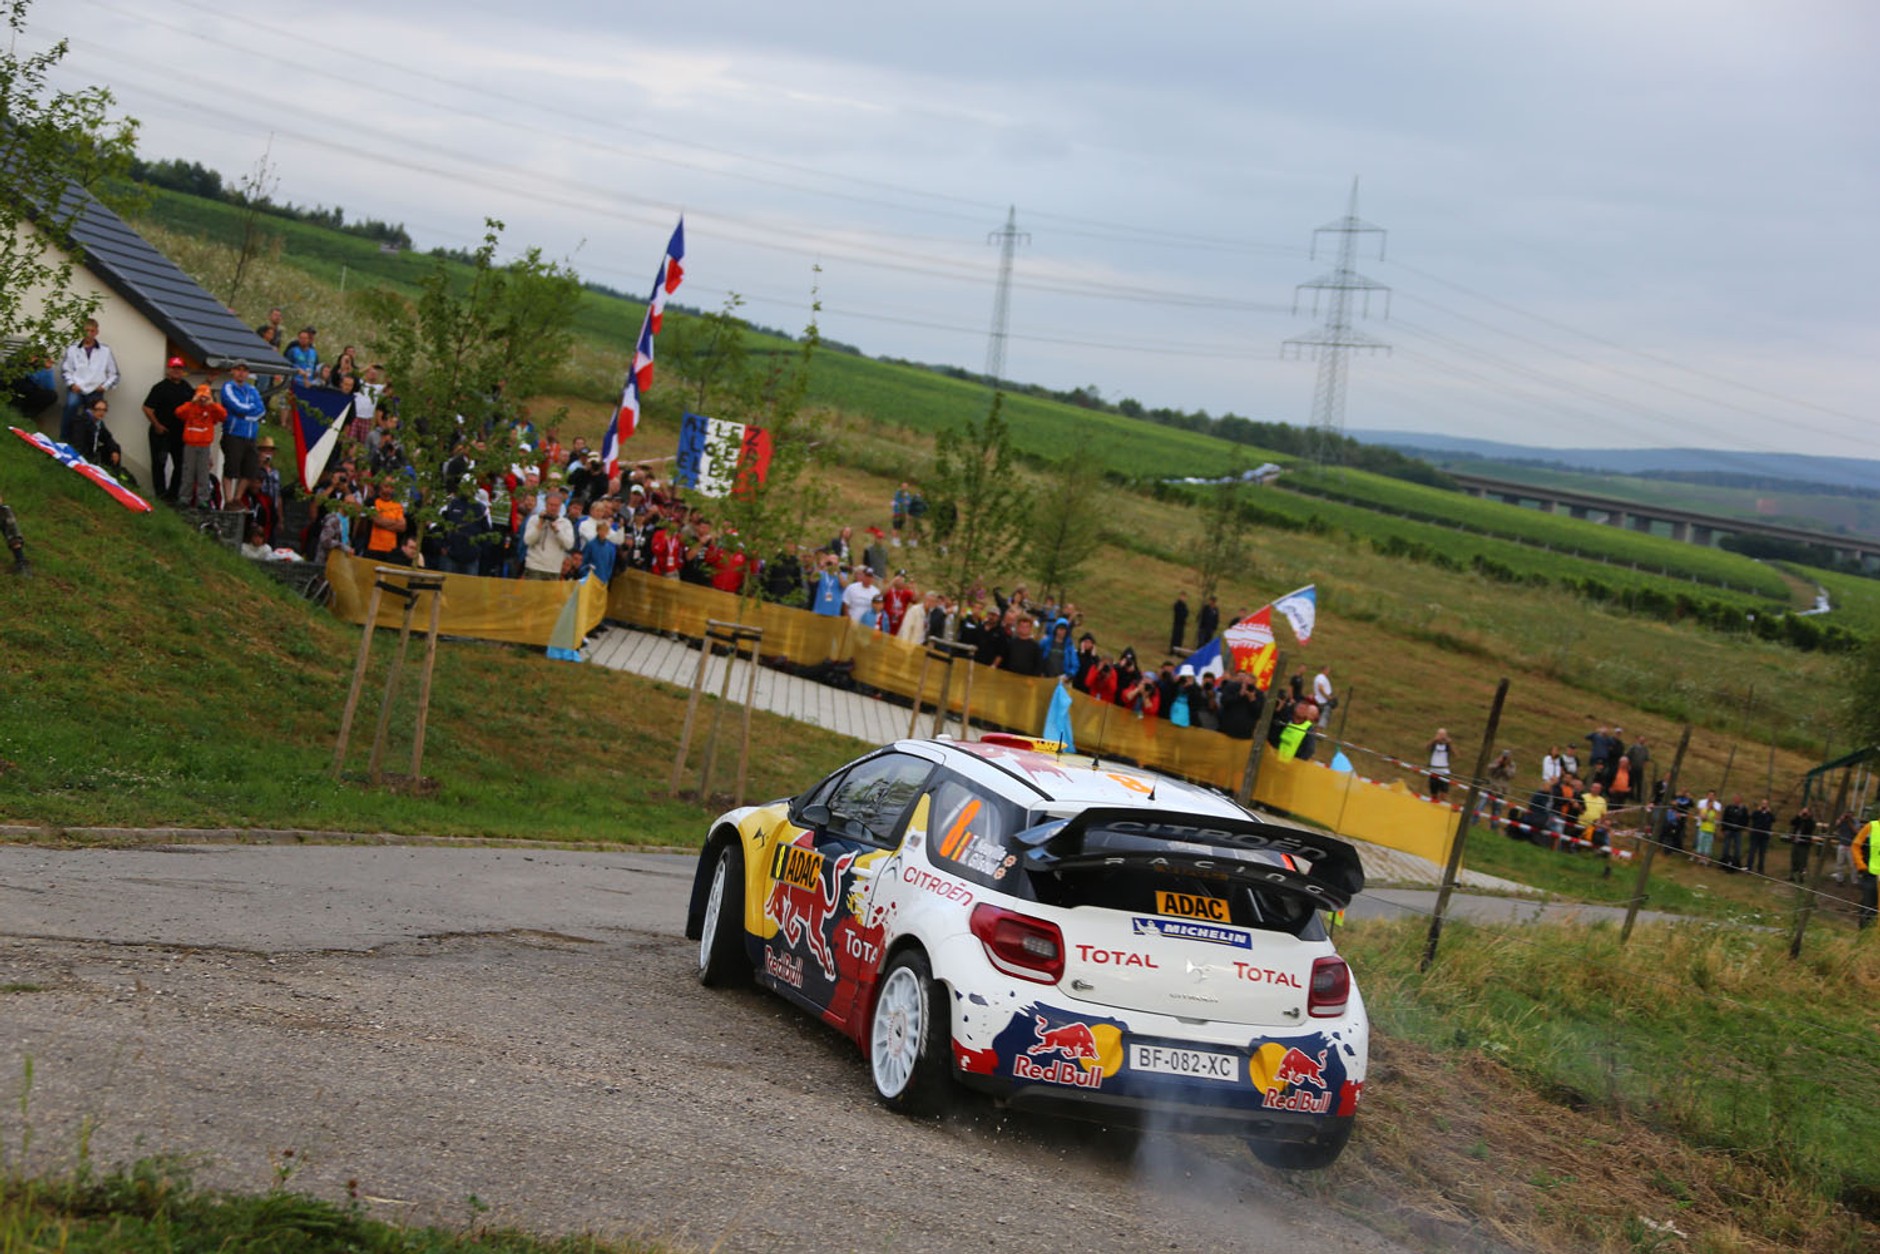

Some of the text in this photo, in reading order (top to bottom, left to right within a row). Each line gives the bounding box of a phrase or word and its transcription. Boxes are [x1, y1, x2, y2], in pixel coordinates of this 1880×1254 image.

[786, 849, 820, 889] ADAC
[1164, 894, 1223, 920] ADAC
[845, 927, 878, 965] TOTA
[1164, 923, 1247, 944] MICHELIN
[1076, 944, 1159, 969] TOTAL
[1233, 961, 1303, 988] TOTAL
[1139, 1047, 1231, 1077] BF-082-XC
